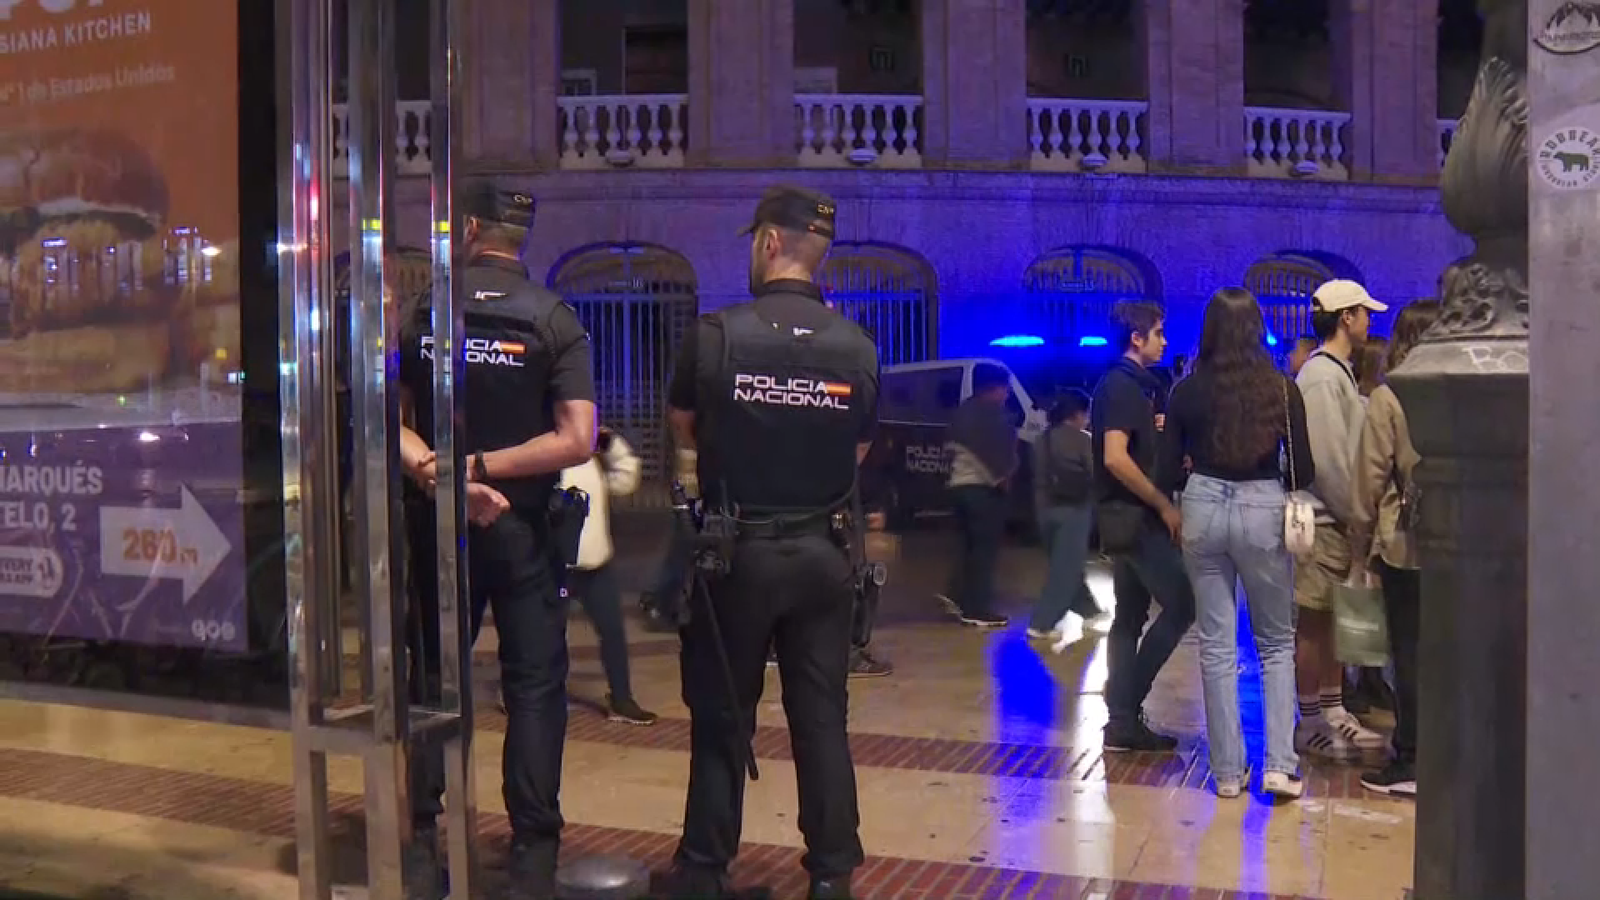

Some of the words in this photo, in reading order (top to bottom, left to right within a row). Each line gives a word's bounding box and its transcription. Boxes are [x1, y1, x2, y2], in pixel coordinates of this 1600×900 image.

[64, 10, 151, 47] KITCHEN
[421, 336, 503, 352] PICIA
[421, 347, 525, 367] NONAL
[735, 373, 828, 394] POLICIA
[734, 388, 849, 410] NACIONAL
[0, 460, 103, 496] ARQUÉS
[61, 502, 77, 531] 2
